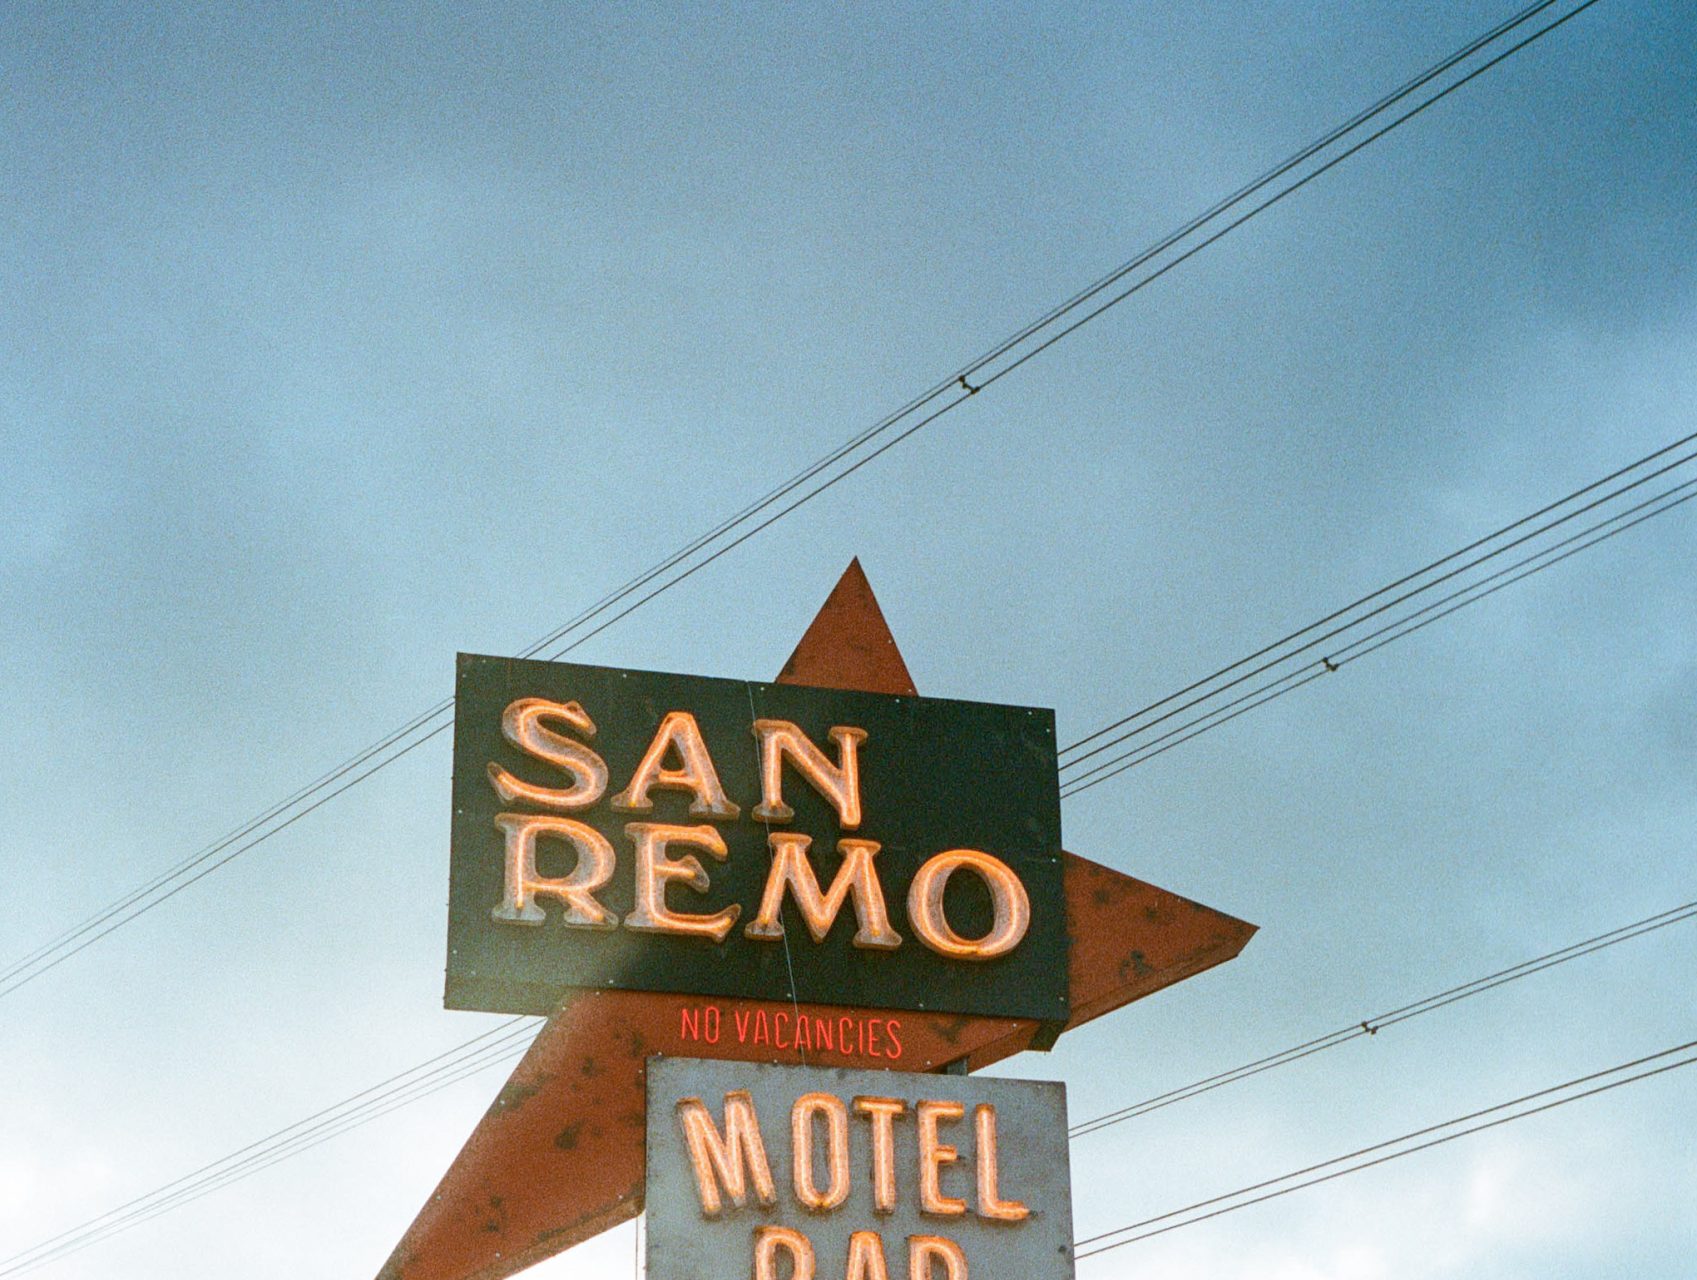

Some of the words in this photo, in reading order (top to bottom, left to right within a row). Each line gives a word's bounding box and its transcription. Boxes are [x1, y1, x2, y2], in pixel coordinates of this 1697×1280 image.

[487, 697, 868, 829] SAN
[491, 813, 1031, 961] REMO
[681, 1006, 720, 1044] NO
[735, 1010, 903, 1059] VACANCIES
[676, 1089, 1030, 1221] MOTEL
